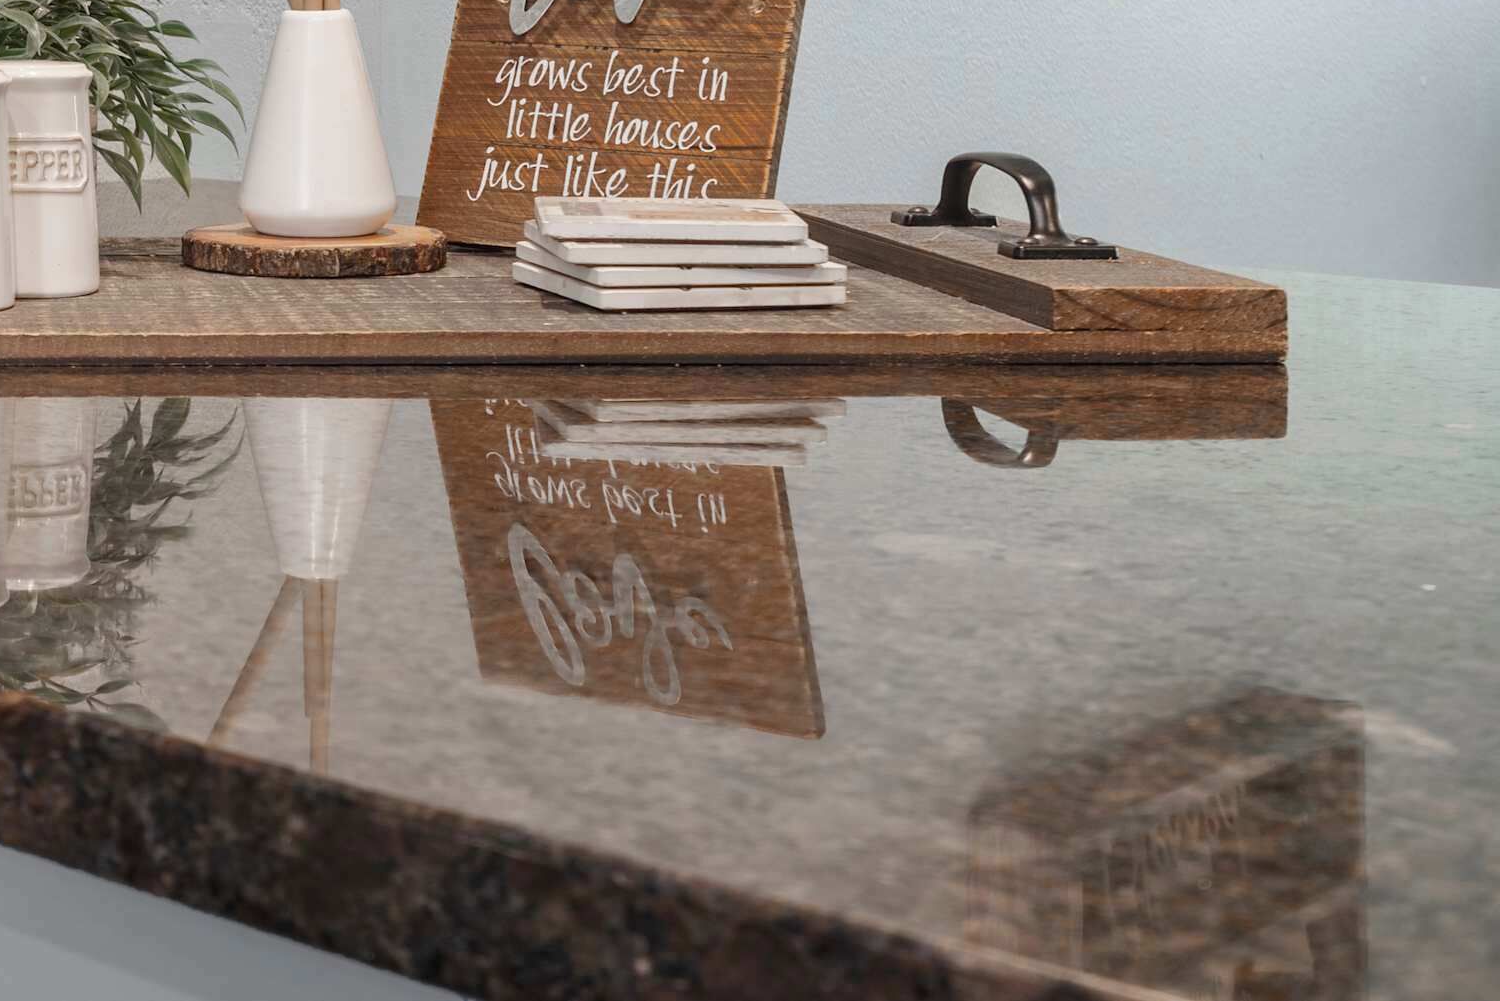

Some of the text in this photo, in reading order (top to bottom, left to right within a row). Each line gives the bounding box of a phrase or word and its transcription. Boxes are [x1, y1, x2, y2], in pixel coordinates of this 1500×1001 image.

[487, 50, 728, 106] grows best in
[506, 98, 721, 152] little houses
[466, 147, 548, 201] just
[563, 151, 629, 199] like
